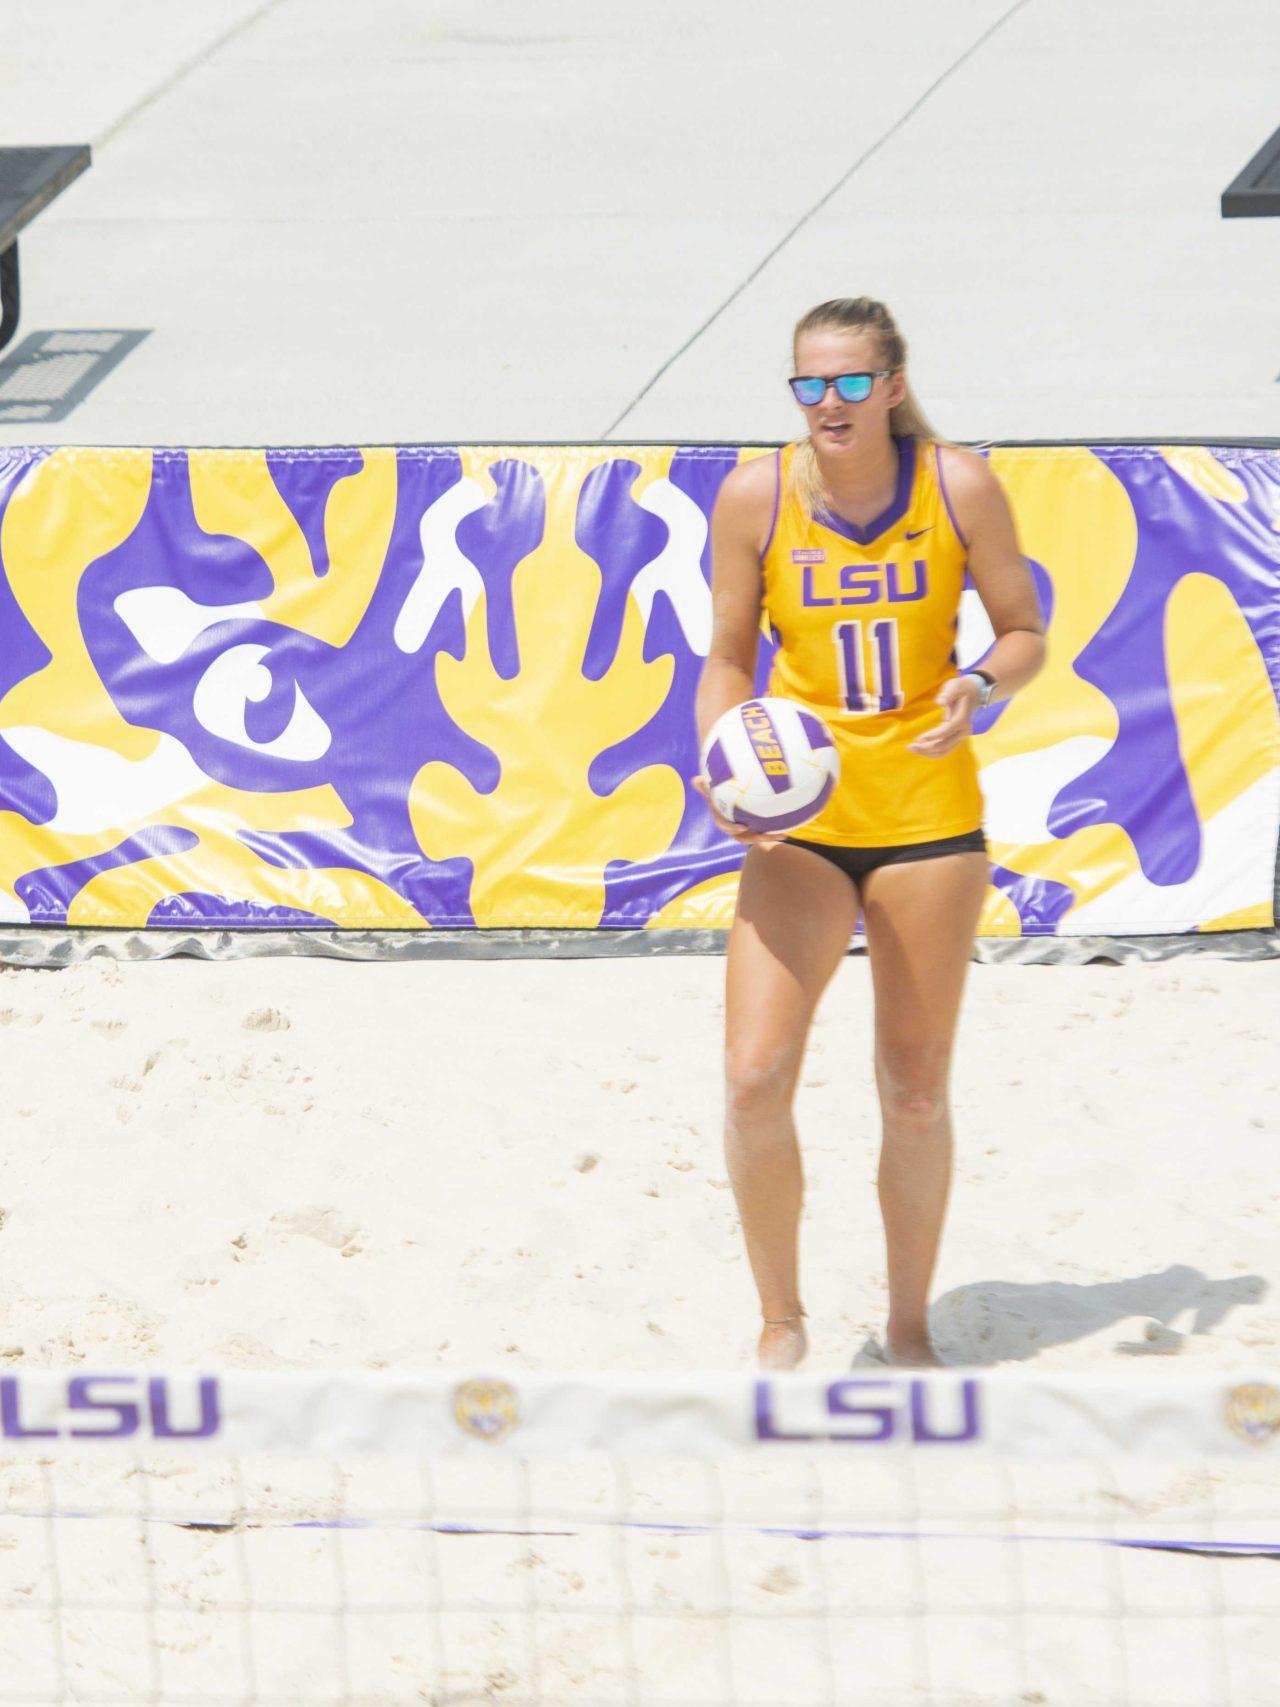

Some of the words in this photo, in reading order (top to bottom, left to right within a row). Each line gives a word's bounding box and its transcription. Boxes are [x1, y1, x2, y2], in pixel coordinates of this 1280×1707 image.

[803, 560, 928, 607] LSU
[832, 618, 905, 715] 11
[741, 706, 790, 775] BEACH
[753, 1379, 984, 1444] LSU
